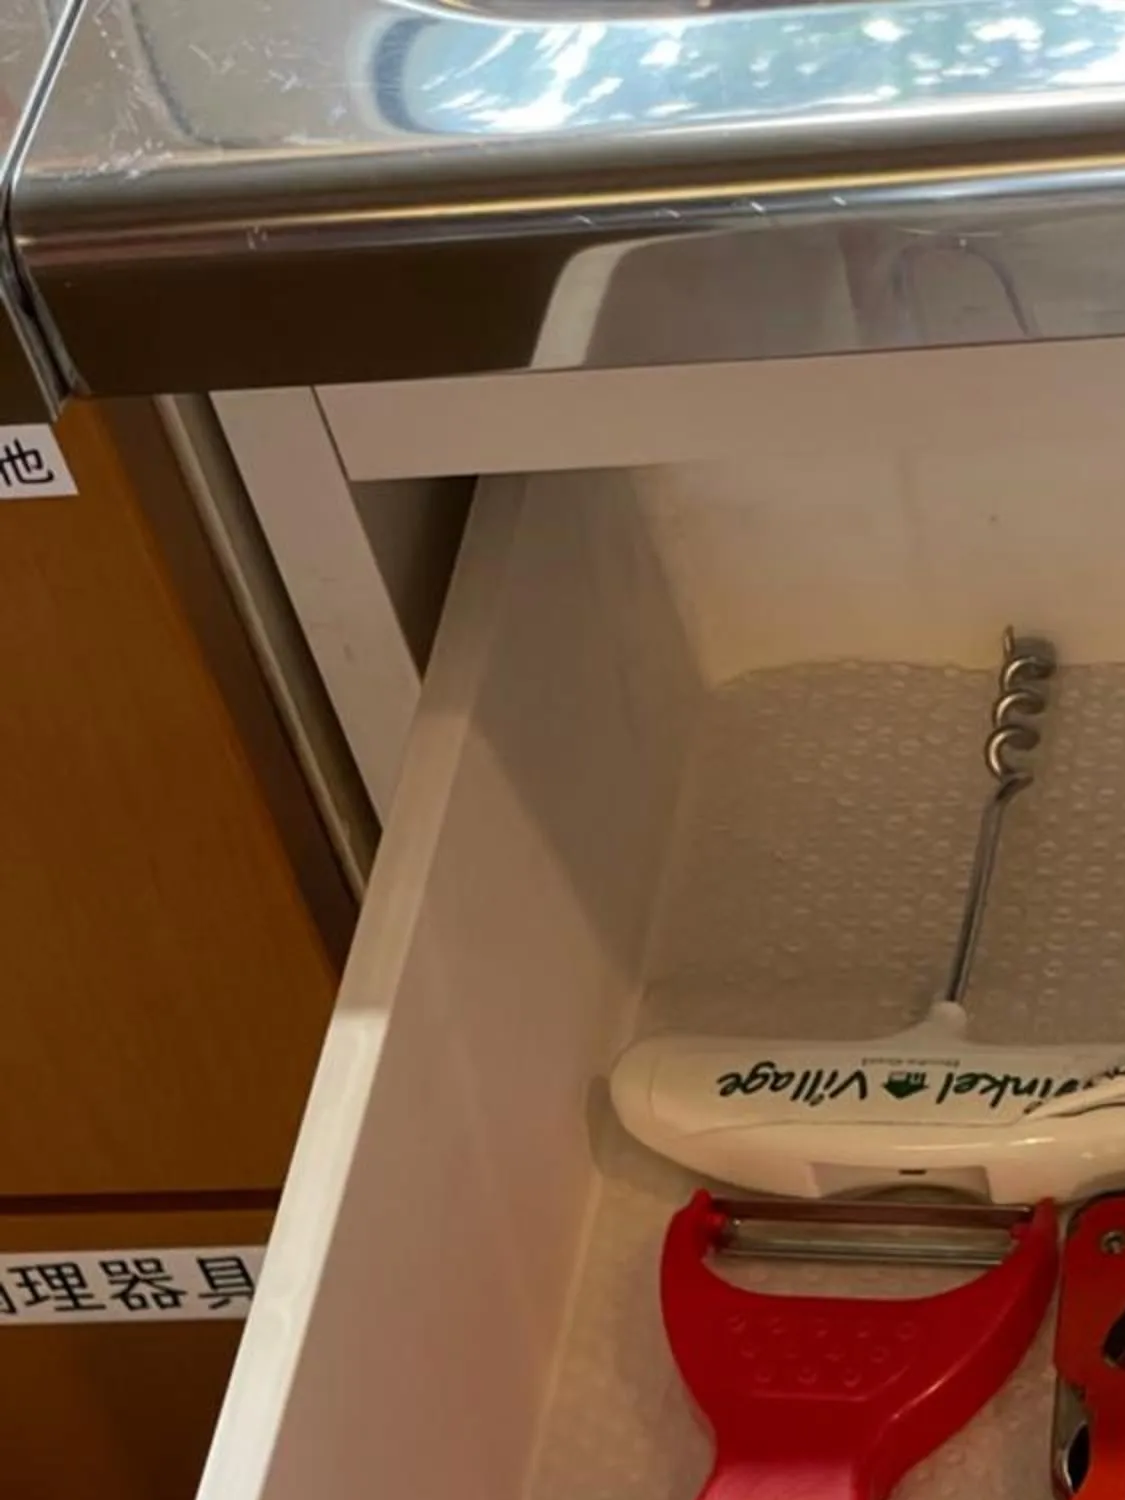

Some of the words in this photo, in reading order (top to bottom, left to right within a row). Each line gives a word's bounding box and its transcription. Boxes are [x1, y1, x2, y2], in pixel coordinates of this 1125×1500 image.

[716, 1061, 868, 1107] Village
[0, 1256, 255, 1314] 理器具
